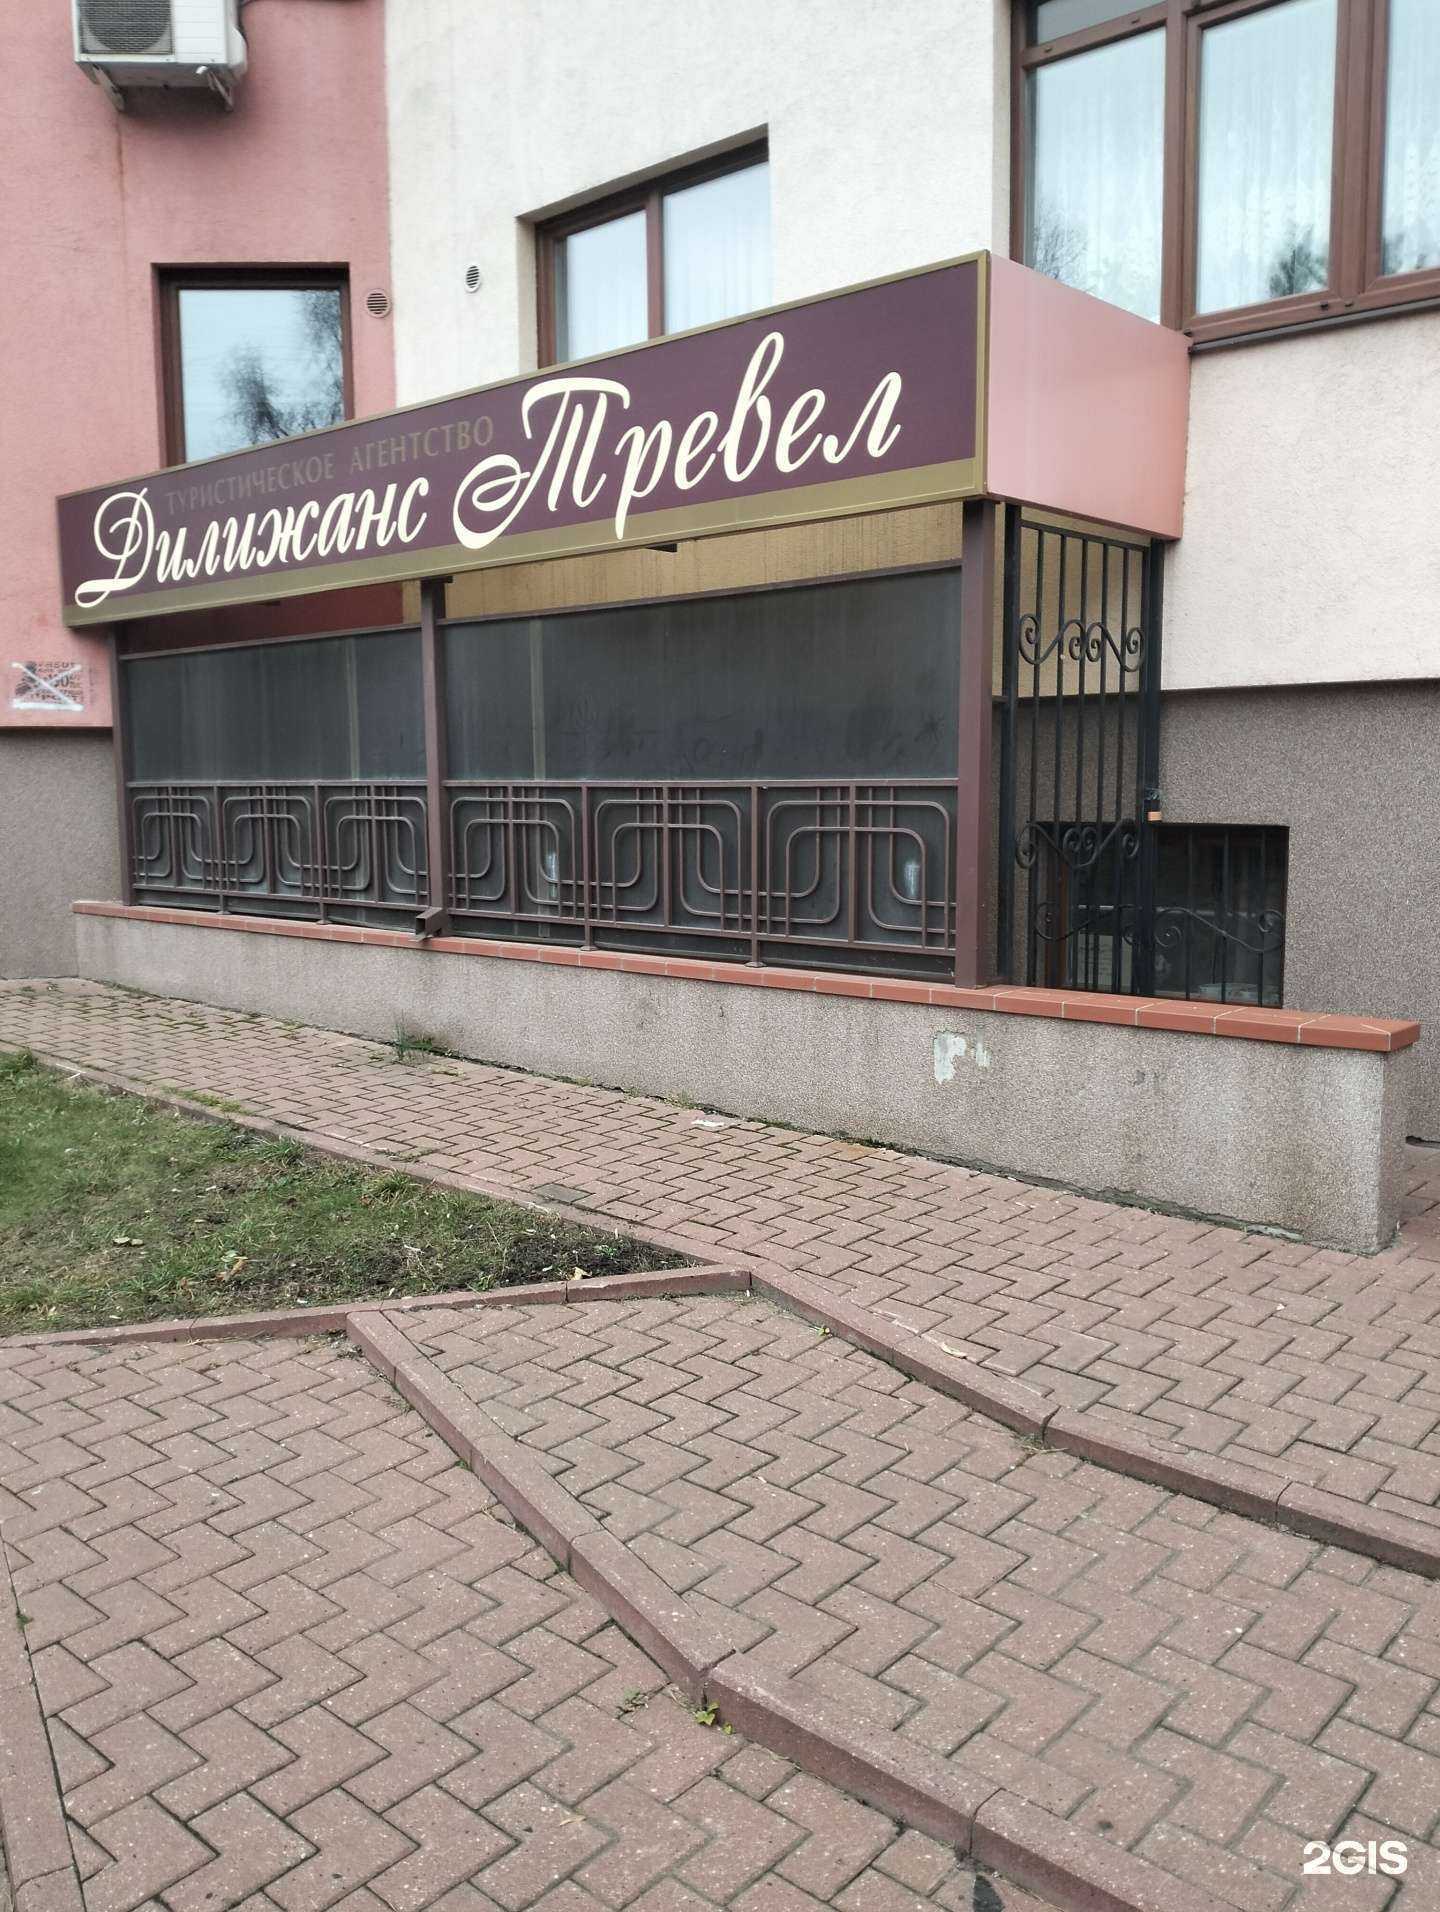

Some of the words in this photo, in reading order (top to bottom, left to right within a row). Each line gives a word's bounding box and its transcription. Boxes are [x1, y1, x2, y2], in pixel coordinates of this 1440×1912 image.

[74, 476, 430, 609] Дилижанс
[452, 331, 902, 550] Тревел
[165, 452, 335, 516] ТУРИСТИЧЕСКОЕ
[350, 415, 494, 475] АГЕНТСТВО
